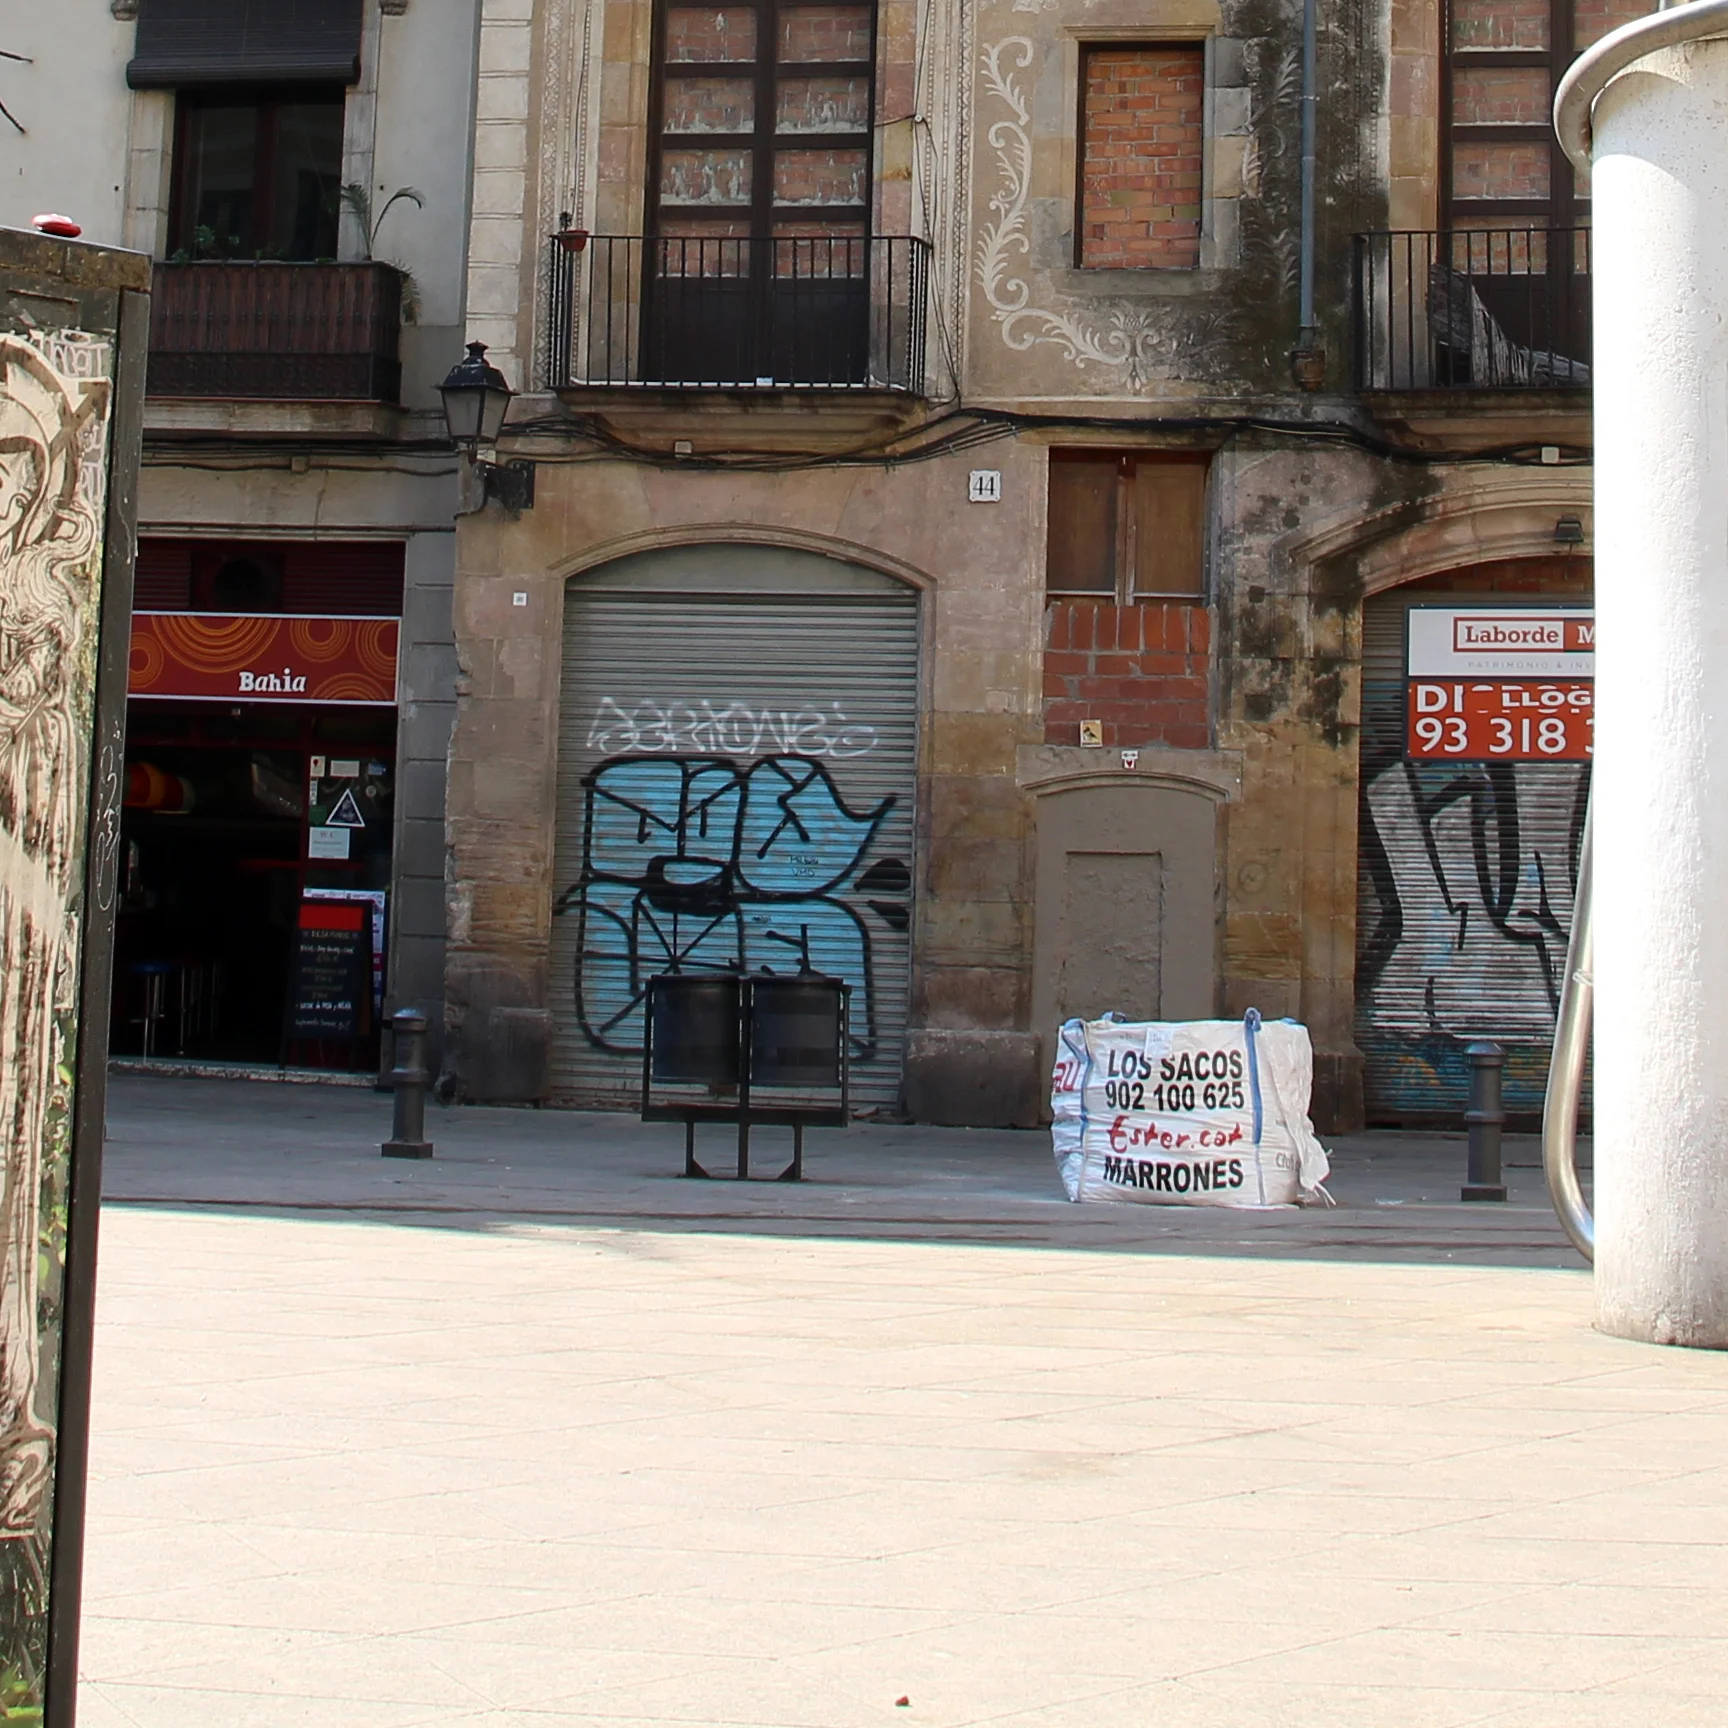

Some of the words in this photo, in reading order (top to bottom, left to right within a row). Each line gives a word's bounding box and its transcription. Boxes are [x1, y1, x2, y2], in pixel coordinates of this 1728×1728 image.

[973, 475, 996, 496] 44
[1465, 625, 1560, 644] Laborde
[238, 667, 307, 692] Bahia
[1468, 661, 1549, 670] PATRIMONIO
[1415, 717, 1469, 753] 93
[1489, 717, 1567, 754] 318
[1107, 1049, 1152, 1080] LOS
[1160, 1049, 1243, 1081] SACOS
[1105, 1082, 1146, 1111] 902
[1153, 1082, 1195, 1112] 100
[1202, 1081, 1245, 1110] 625
[1103, 1155, 1244, 1194] MARRONES
